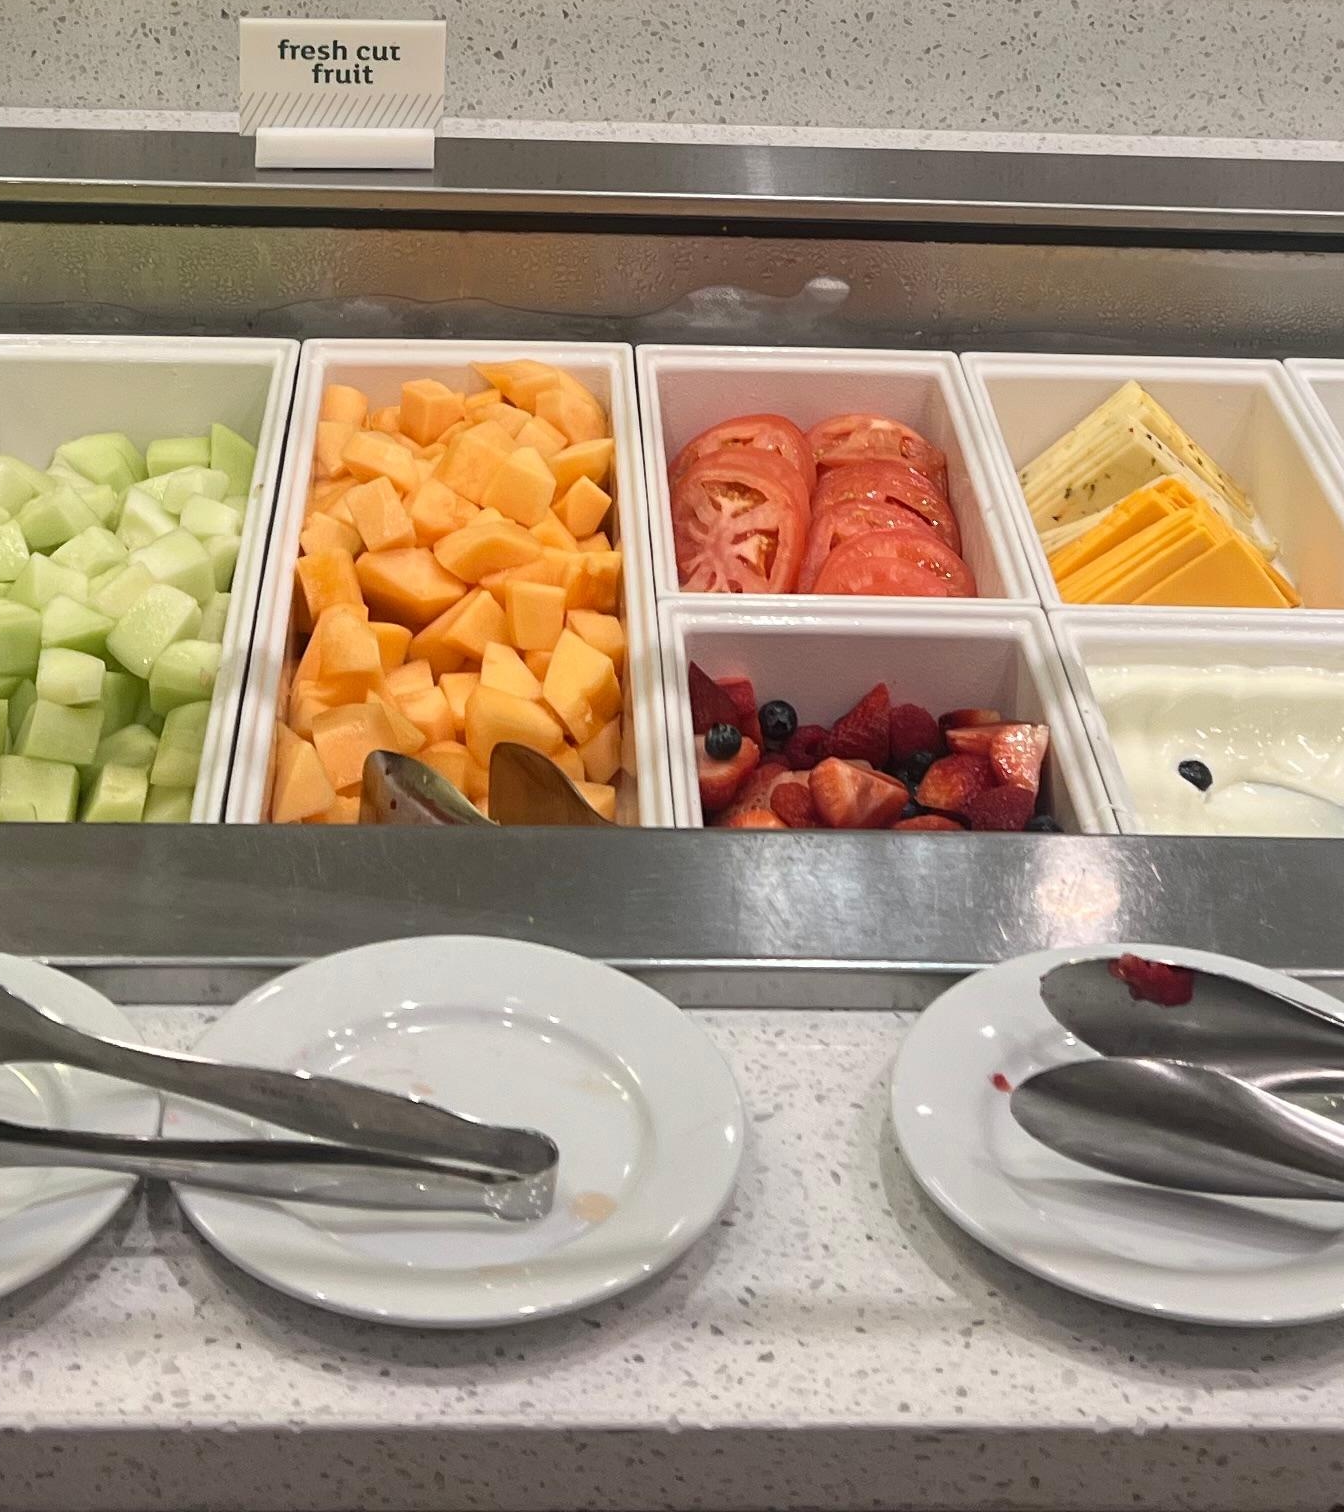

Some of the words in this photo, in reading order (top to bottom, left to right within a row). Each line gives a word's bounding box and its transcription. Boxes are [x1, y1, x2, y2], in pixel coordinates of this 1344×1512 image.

[277, 38, 348, 61] fresh
[355, 44, 401, 62] cut
[311, 63, 375, 85] fruit
